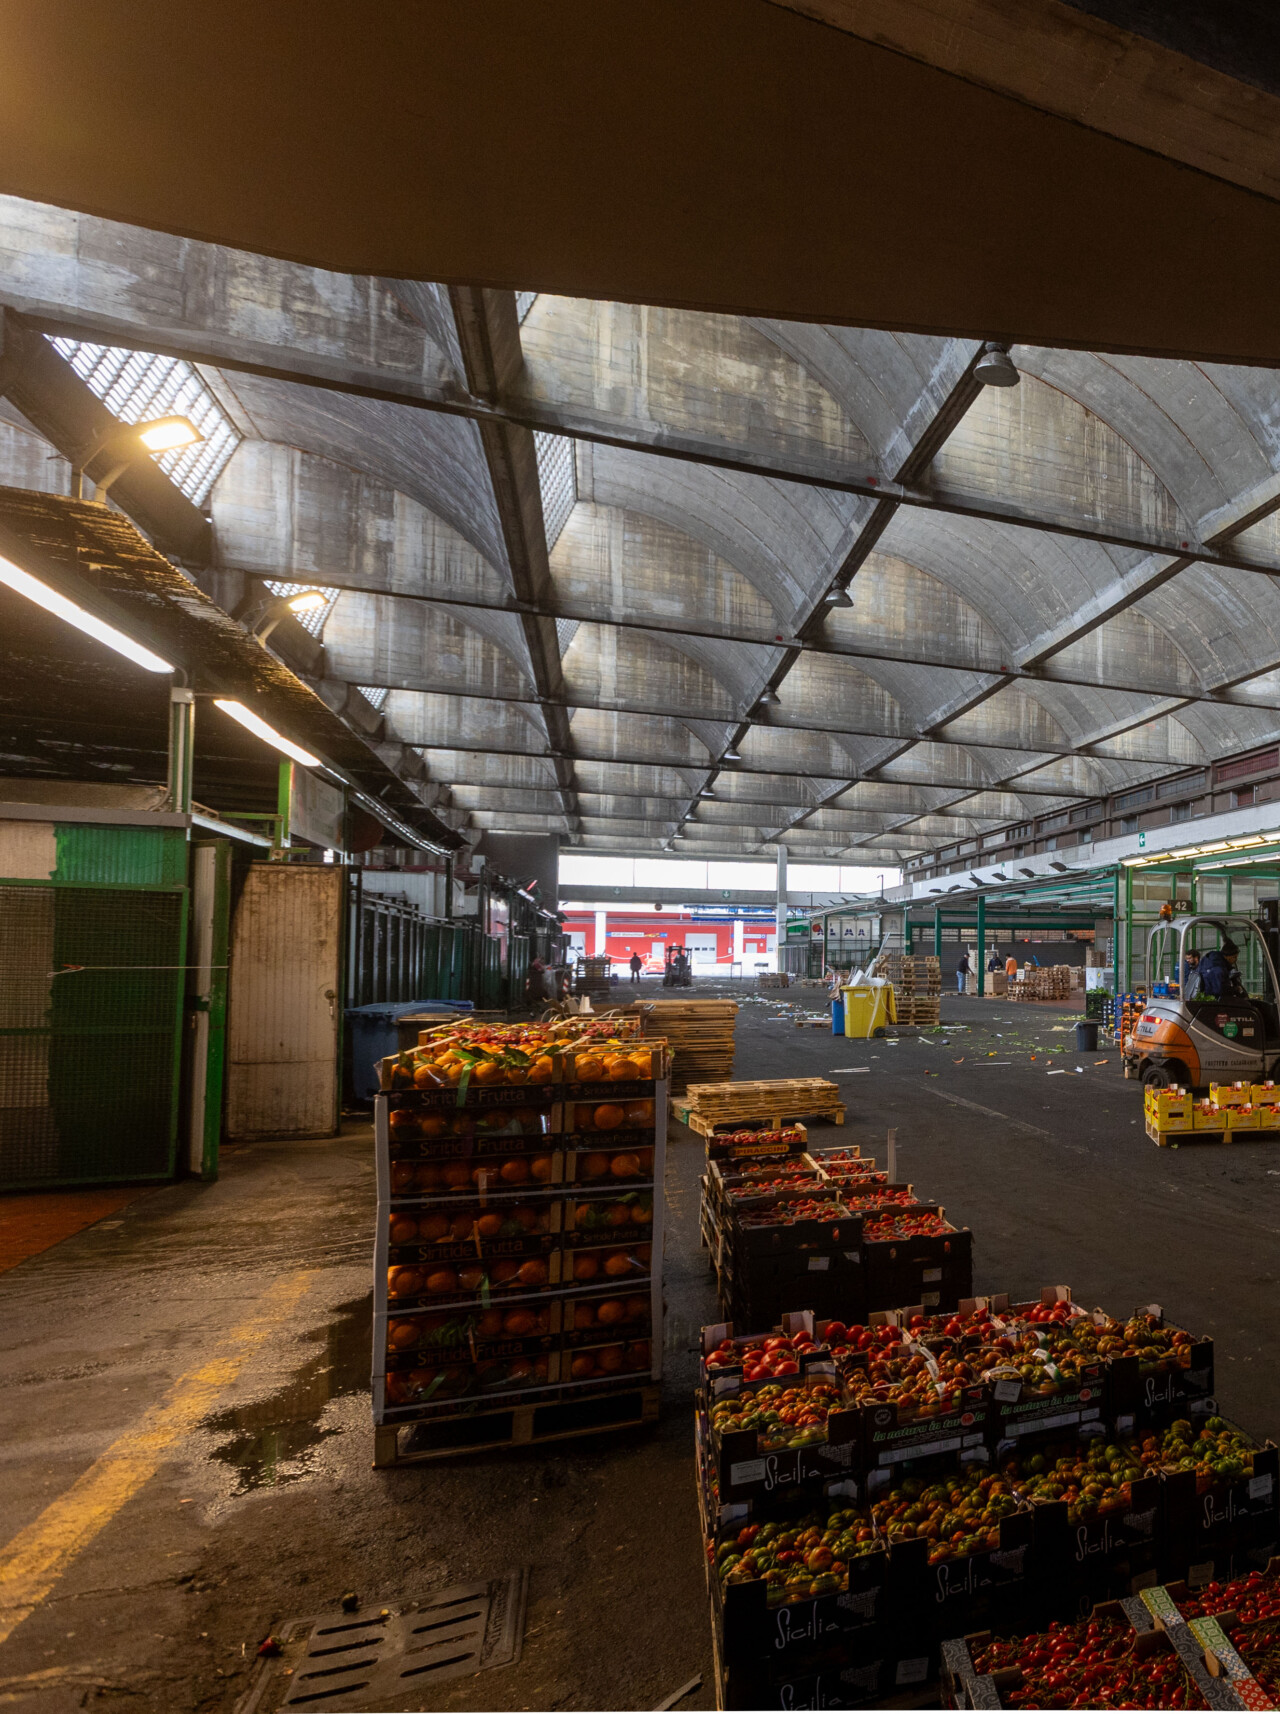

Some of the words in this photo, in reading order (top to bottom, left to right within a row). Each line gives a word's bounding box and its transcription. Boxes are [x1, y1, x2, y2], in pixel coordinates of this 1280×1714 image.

[1175, 901, 1187, 911] 42
[420, 1090, 475, 1106] Siritie
[478, 1088, 525, 1102] Frutta
[419, 1140, 465, 1156] Siritid
[477, 1138, 525, 1152] Frutta
[736, 1145, 787, 1155] PIRACCINI
[418, 1244, 473, 1261] Siritide
[417, 1347, 472, 1366] Siritide
[476, 1342, 523, 1357] Frutta
[1144, 1373, 1187, 1408] Sicilia
[764, 1449, 822, 1491] Sicilia
[1203, 1488, 1249, 1529] Sicilia
[1075, 1519, 1125, 1562] Sicilia
[935, 1558, 992, 1604] Sicilia
[774, 1600, 840, 1650] Sicilia
